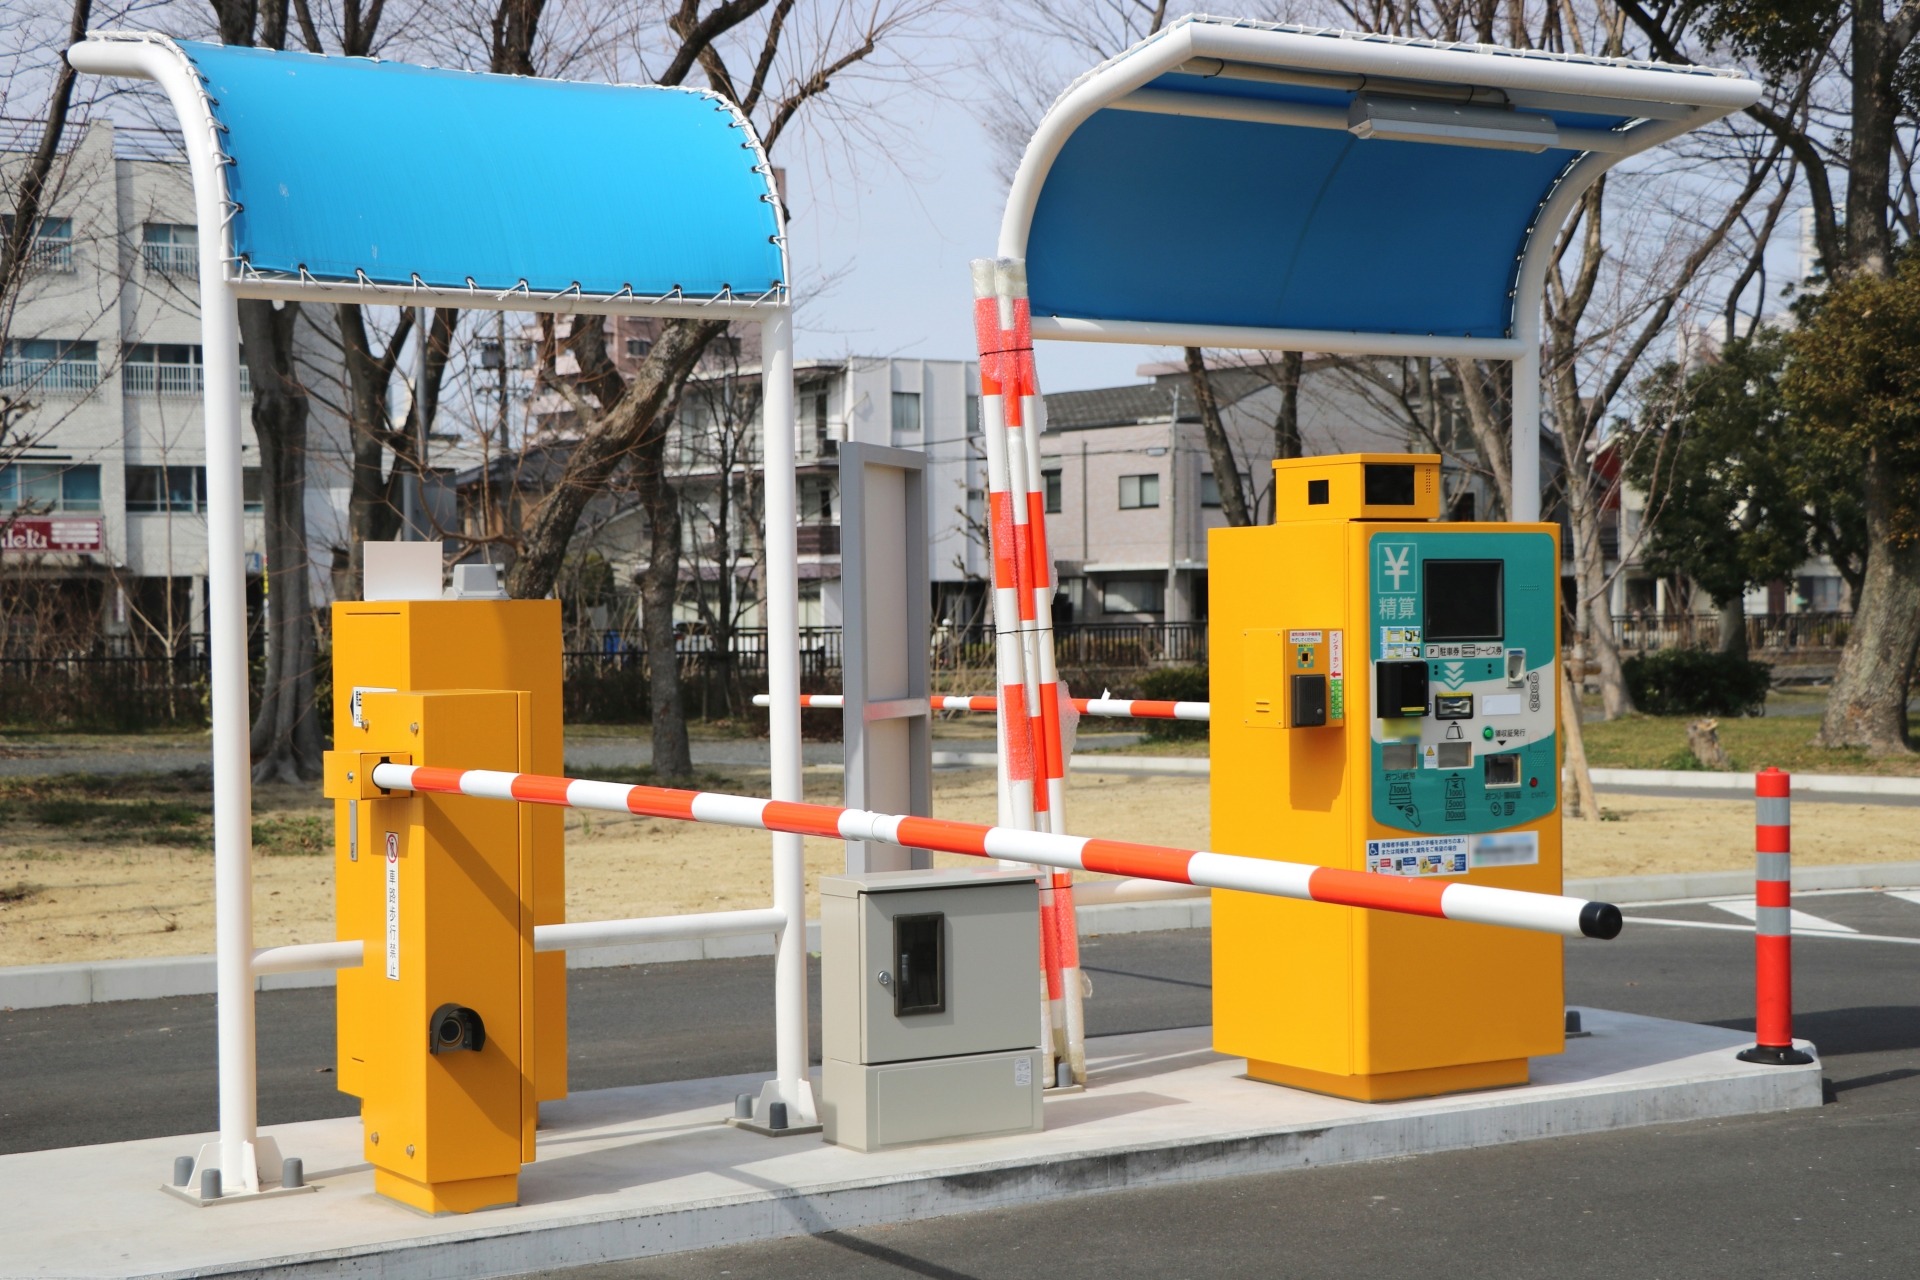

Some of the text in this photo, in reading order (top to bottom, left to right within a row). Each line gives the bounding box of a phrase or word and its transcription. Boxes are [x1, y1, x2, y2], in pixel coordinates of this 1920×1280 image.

[1384, 546, 1410, 591] ¥
[1379, 597, 1417, 620] 精算
[1332, 632, 1340, 669] インターホン
[1440, 647, 1460, 656] 駐車券
[1476, 646, 1502, 656] サービス券
[1495, 729, 1526, 738] 領収証発行
[1393, 785, 1408, 794] 1000
[1448, 800, 1463, 808] 5000
